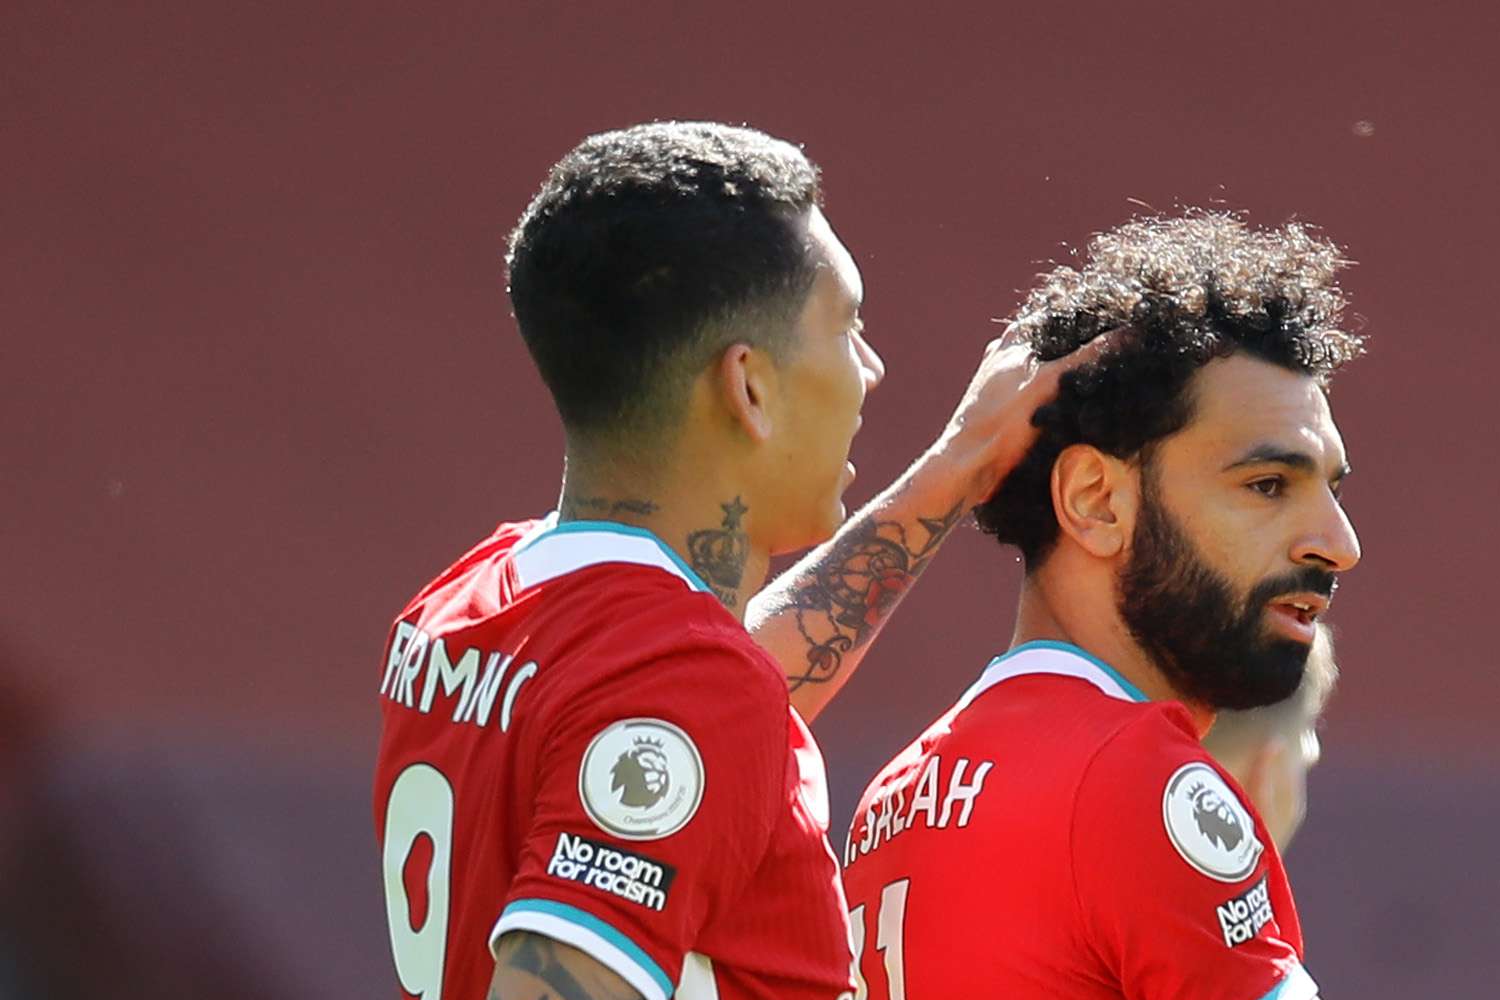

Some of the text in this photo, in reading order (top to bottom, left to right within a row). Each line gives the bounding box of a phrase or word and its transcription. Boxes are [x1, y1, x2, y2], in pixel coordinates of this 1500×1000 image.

[554, 832, 663, 887] No room
[547, 853, 666, 911] for racism
[1217, 900, 1248, 925] No
[1224, 918, 1253, 948] for
